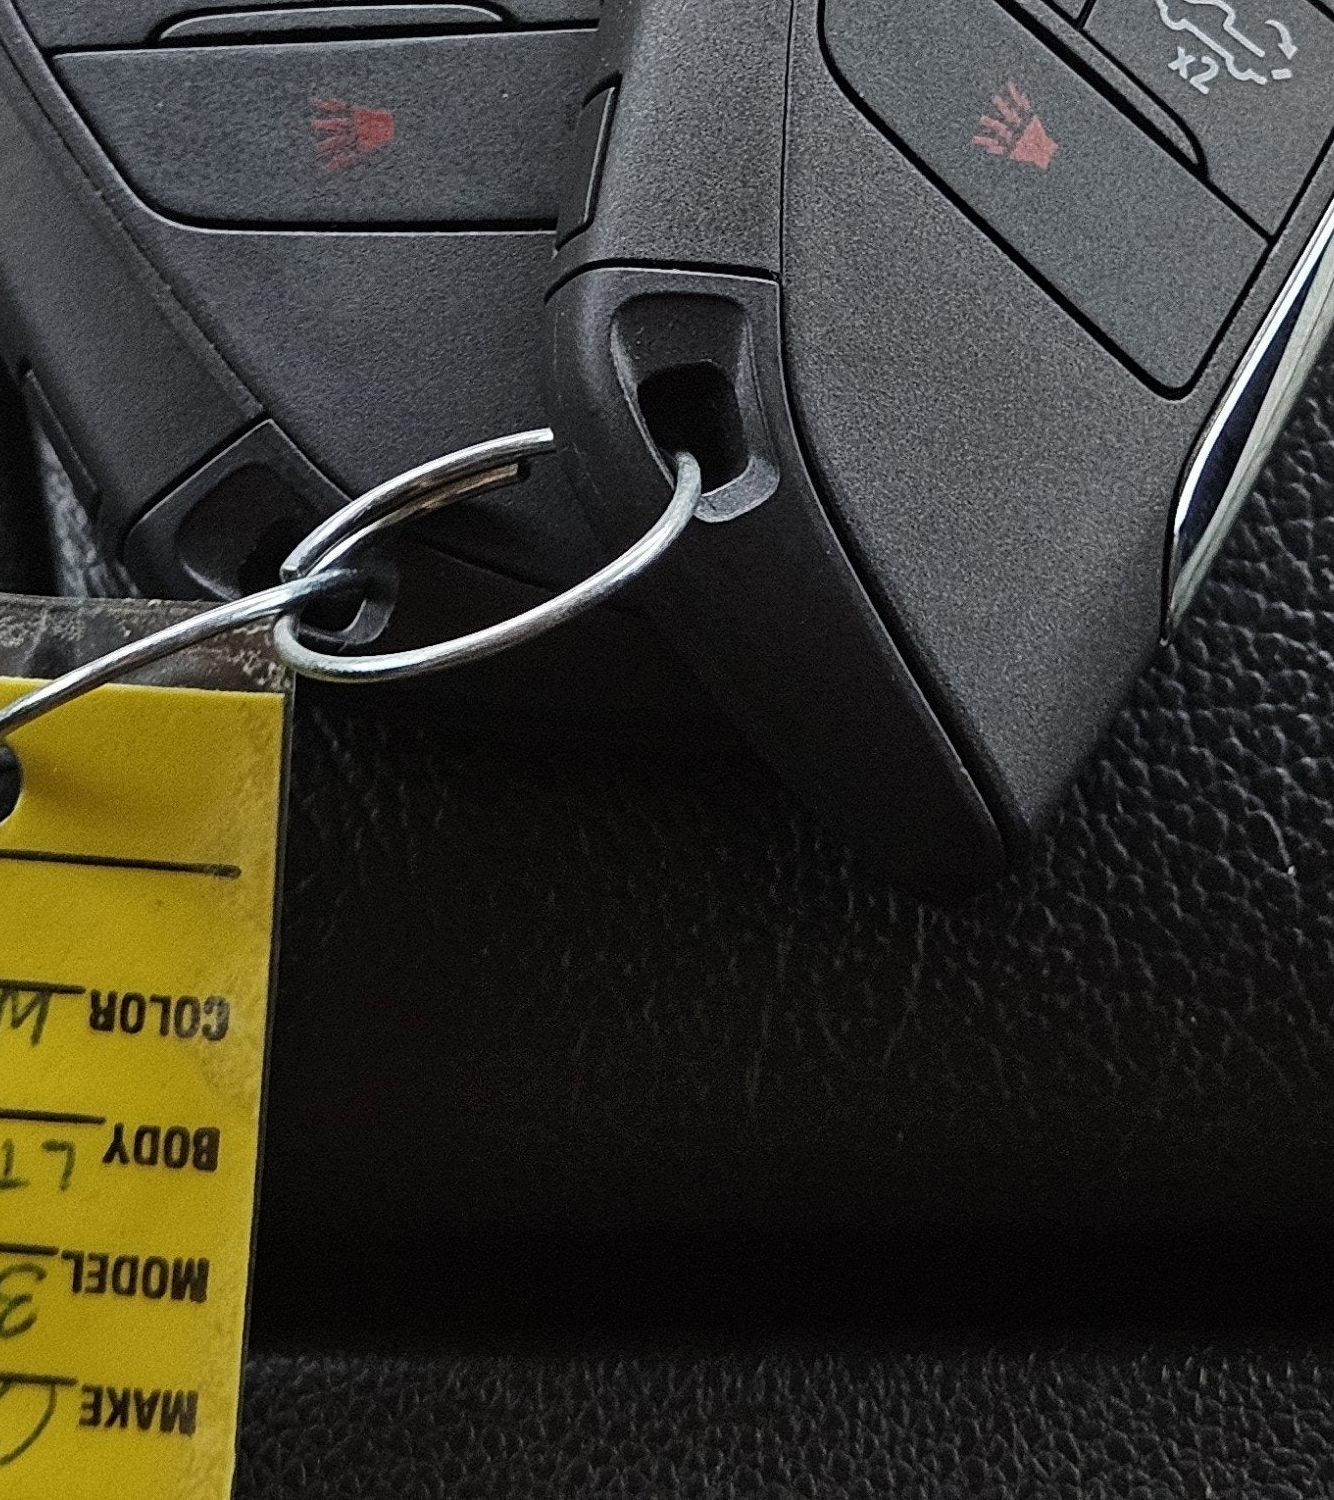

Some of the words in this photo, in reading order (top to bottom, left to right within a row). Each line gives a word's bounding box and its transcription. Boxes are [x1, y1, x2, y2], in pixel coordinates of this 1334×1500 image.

[89, 990, 229, 1041] COLOR
[103, 1122, 221, 1172] BODY
[61, 1251, 209, 1302] MODEL
[79, 1384, 198, 1436] MAKE
